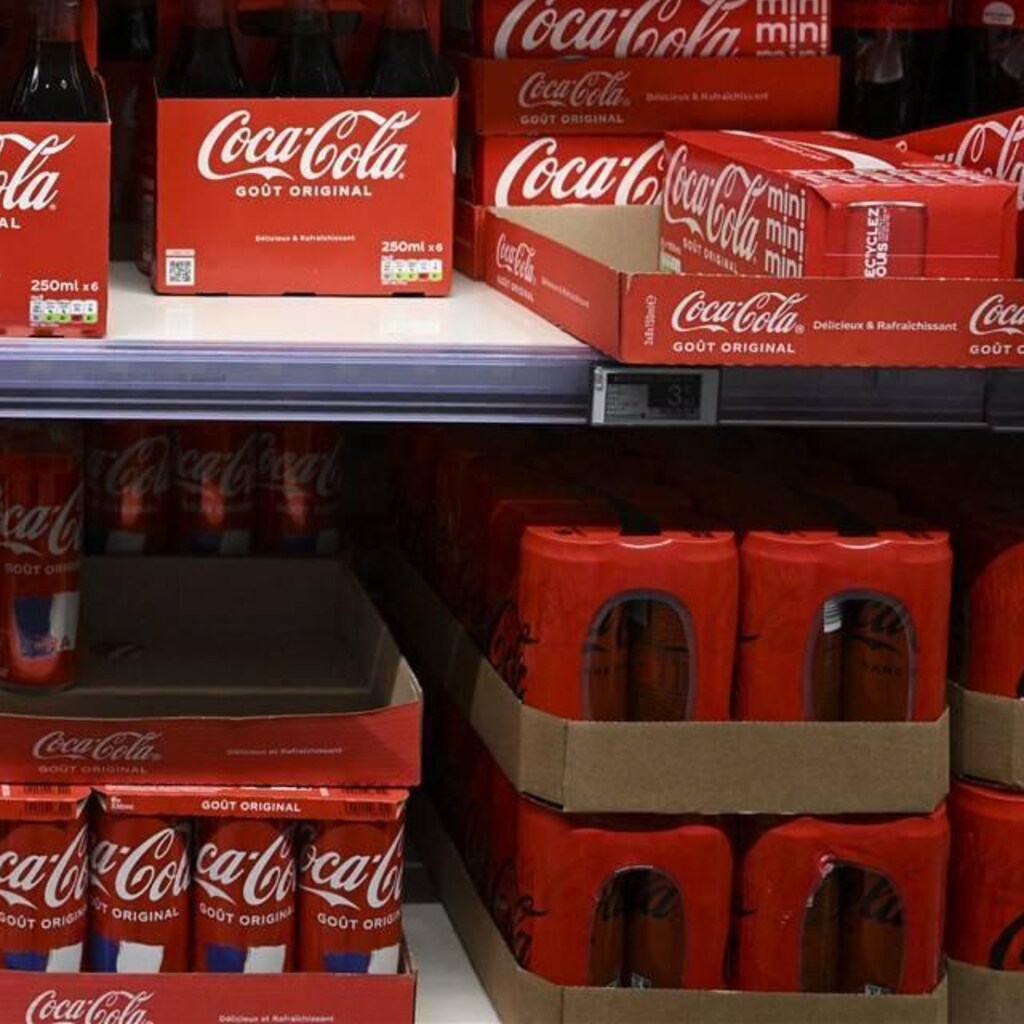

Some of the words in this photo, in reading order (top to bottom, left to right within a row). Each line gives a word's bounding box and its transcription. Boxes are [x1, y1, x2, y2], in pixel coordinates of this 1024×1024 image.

[755, 16, 828, 44] mini
[518, 70, 633, 109] Coca-Cola
[521, 112, 556, 125] GOÛT
[560, 113, 625, 125] ORIGINAL
[197, 109, 422, 181] Coca-Cola
[236, 182, 281, 197] GOÛT
[289, 185, 372, 198] ORIGINAL
[663, 144, 769, 262] Coca-Cola
[767, 187, 807, 218] mini
[765, 216, 805, 252] mini
[865, 207, 878, 278] ECYCLEZ
[381, 240, 425, 253] 250ml
[763, 248, 803, 278] mini
[31, 279, 79, 293] 250ml
[672, 290, 809, 334] Coca-Cola
[813, 320, 864, 330] Délicieux
[866, 321, 874, 330] &
[877, 320, 957, 332] Rafraîchissant
[674, 338, 716, 354] GOÛT
[721, 341, 796, 354] ORIGINAL
[969, 342, 1011, 356] GOÛT
[32, 729, 163, 761] Coca-Cola
[201, 799, 236, 812] GOÛT
[240, 801, 302, 813] ORIGINAL
[112, 907, 180, 923] ORIGINAL
[199, 902, 234, 925] GOÛT
[317, 912, 358, 930] GOÛT
